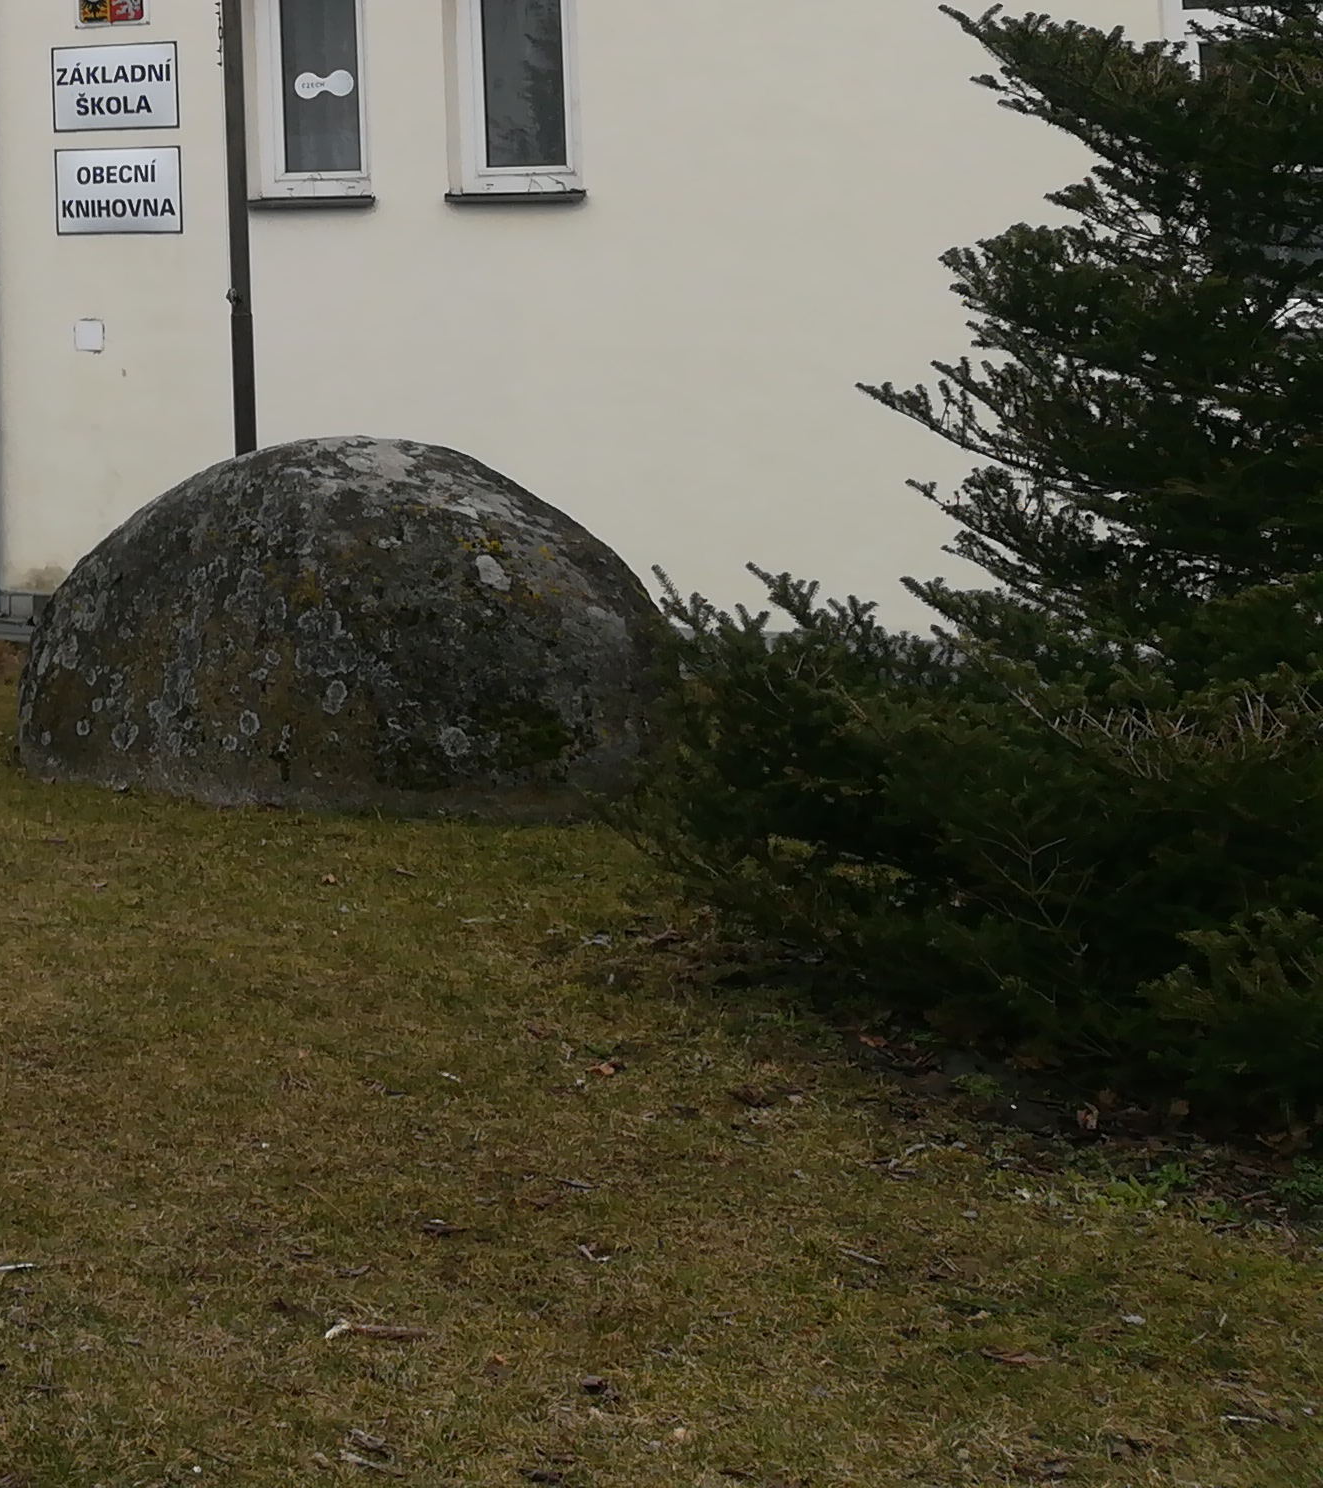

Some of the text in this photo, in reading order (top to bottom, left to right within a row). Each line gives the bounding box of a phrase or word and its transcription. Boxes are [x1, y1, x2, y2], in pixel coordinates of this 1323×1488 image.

[56, 58, 172, 86] ZÁKLADNÍ
[75, 92, 153, 116] ŠKOLA
[76, 158, 157, 185] OBECNÍ
[61, 198, 176, 219] KNIHOVNA
